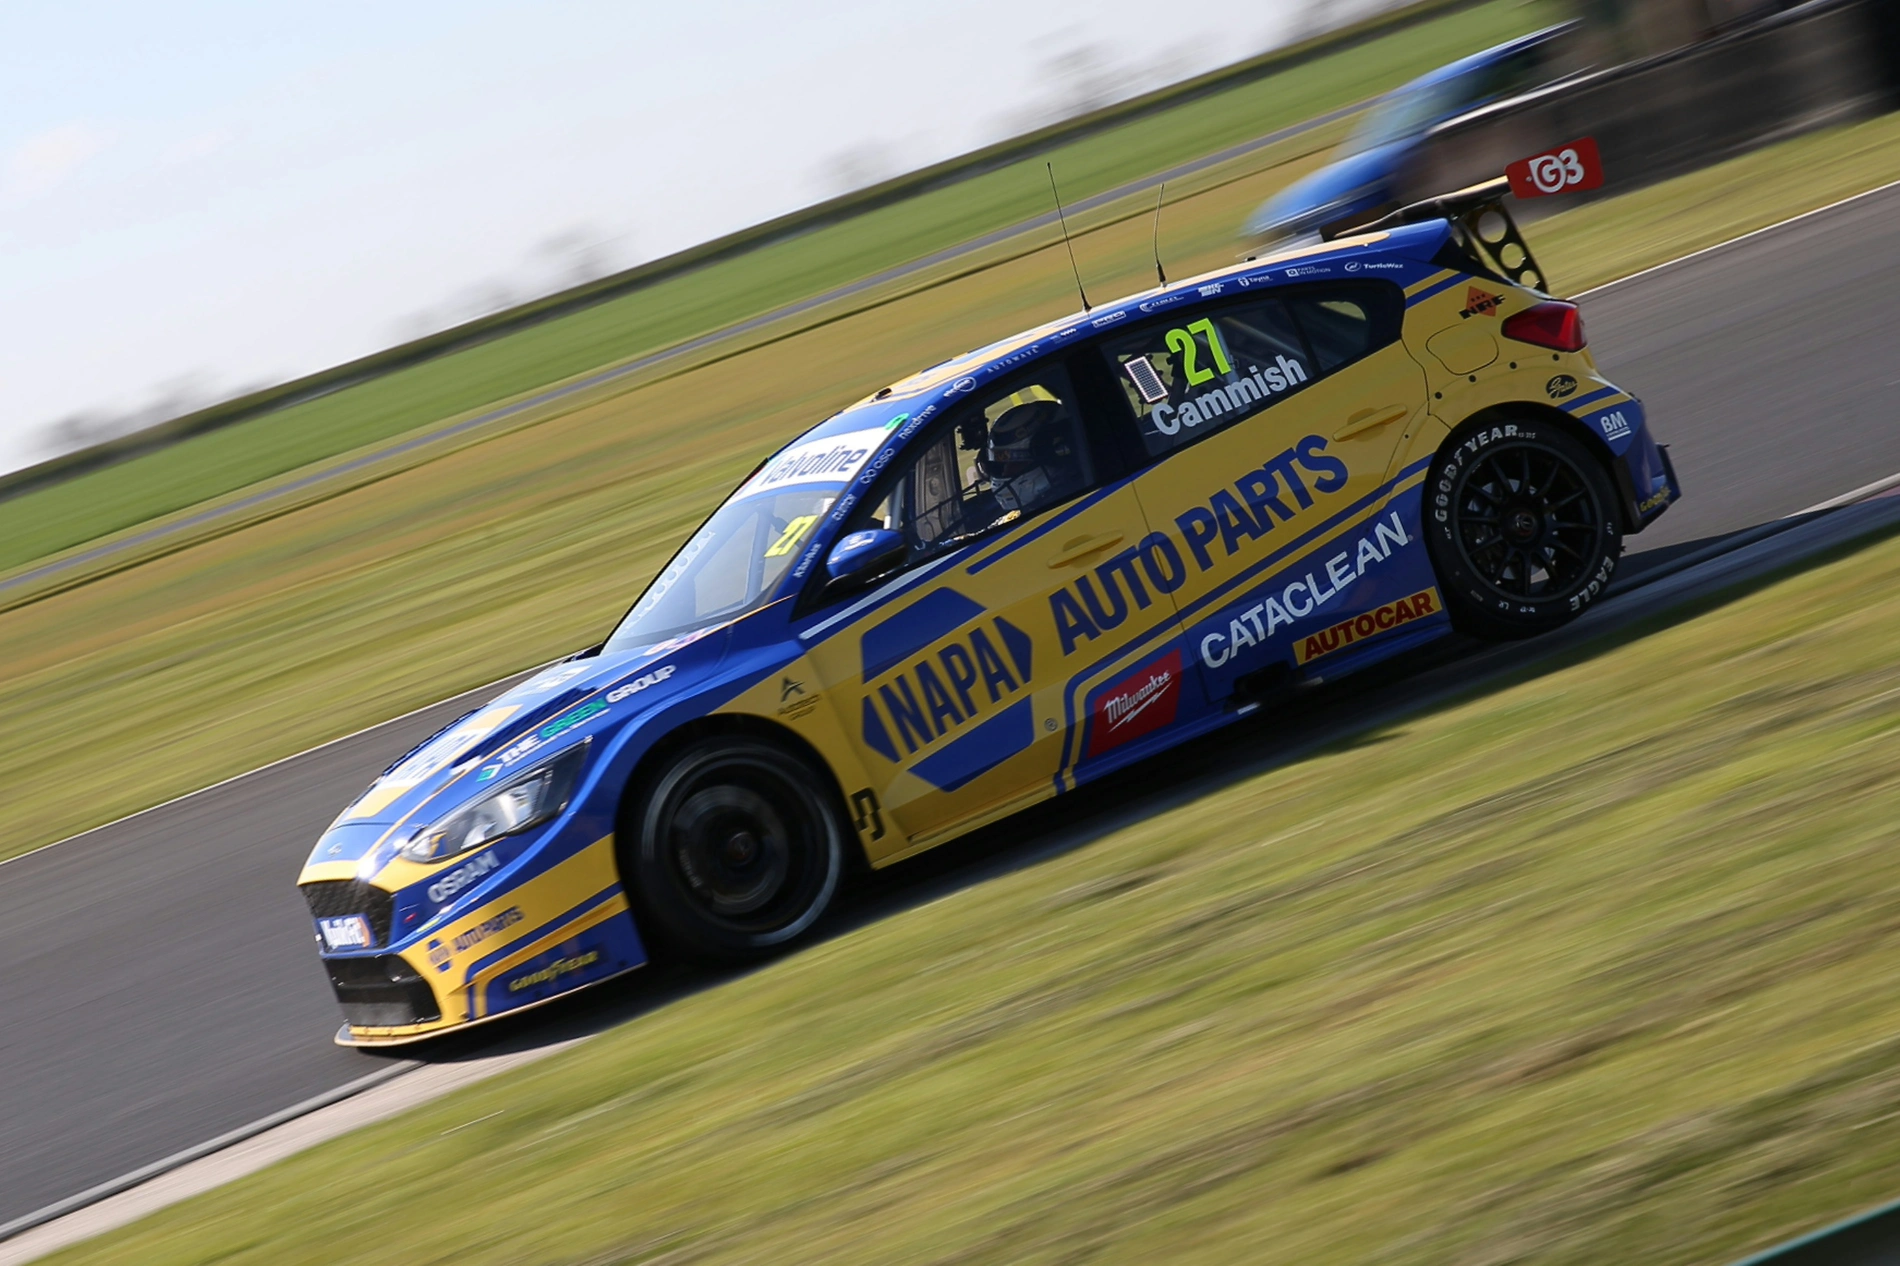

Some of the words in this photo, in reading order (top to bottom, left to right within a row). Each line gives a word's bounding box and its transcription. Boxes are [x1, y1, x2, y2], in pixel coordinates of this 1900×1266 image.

[1528, 148, 1585, 194] G3
[1458, 294, 1506, 320] NRE
[1165, 317, 1231, 387] 27
[1151, 354, 1308, 436] Cammish
[1600, 411, 1628, 434] BM
[1048, 530, 1187, 657] AUTO
[1174, 434, 1349, 573] PARTS
[1200, 511, 1410, 669] CATACLEAN
[1569, 556, 1615, 612] EAGLE
[1304, 591, 1435, 661] AUTOCAR
[496, 734, 541, 765] THE
[539, 697, 608, 739] GREEN
[605, 664, 677, 704] GROUP
[877, 628, 1019, 756] NAPA
[1101, 669, 1171, 725] Milwaukee
[427, 850, 500, 904] OSRAM
